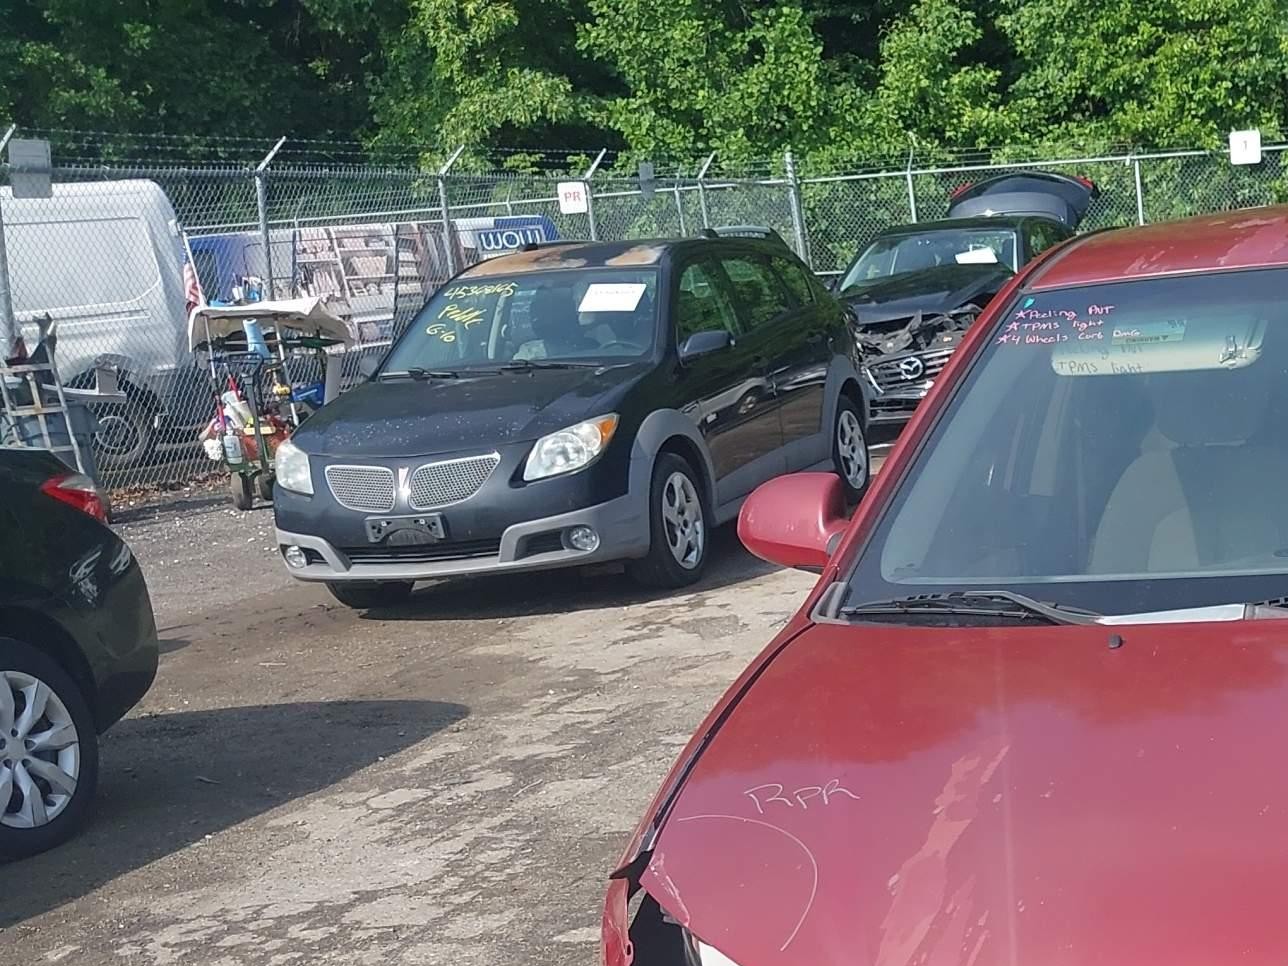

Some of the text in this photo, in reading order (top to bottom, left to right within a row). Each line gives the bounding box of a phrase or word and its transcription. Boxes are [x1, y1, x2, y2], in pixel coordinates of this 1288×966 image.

[563, 191, 582, 203] PR
[1029, 310, 1077, 321] Peeling
[1022, 320, 1104, 332] TPMS light
[1025, 334, 1069, 344] Wheels
[744, 778, 860, 814] RPR
